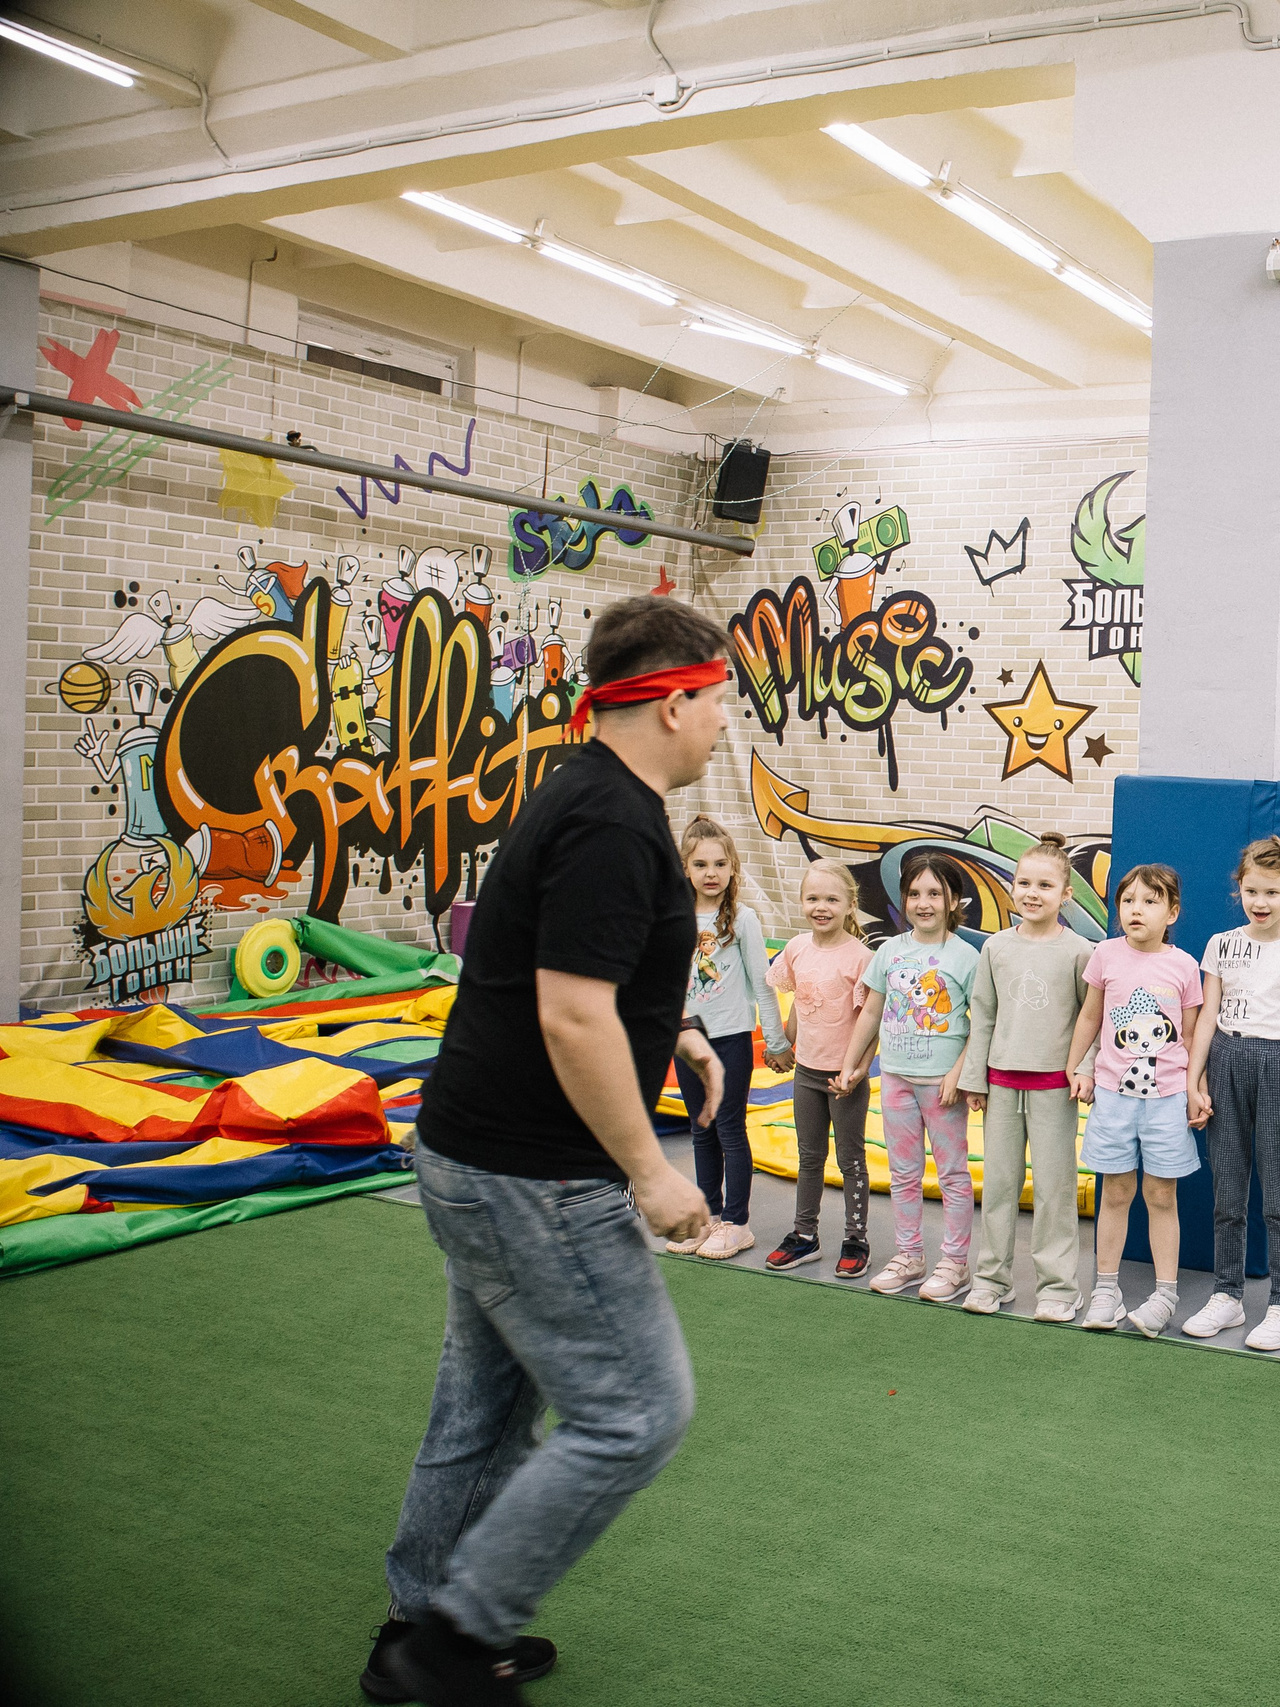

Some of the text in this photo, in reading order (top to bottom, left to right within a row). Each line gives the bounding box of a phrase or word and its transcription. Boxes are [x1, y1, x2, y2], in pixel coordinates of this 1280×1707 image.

[1069, 583, 1144, 626] БОЛЬ
[1092, 626, 1143, 655] ГОН
[90, 914, 208, 985] БОЛЬШИЕ
[110, 957, 190, 1003] ГОНКИ
